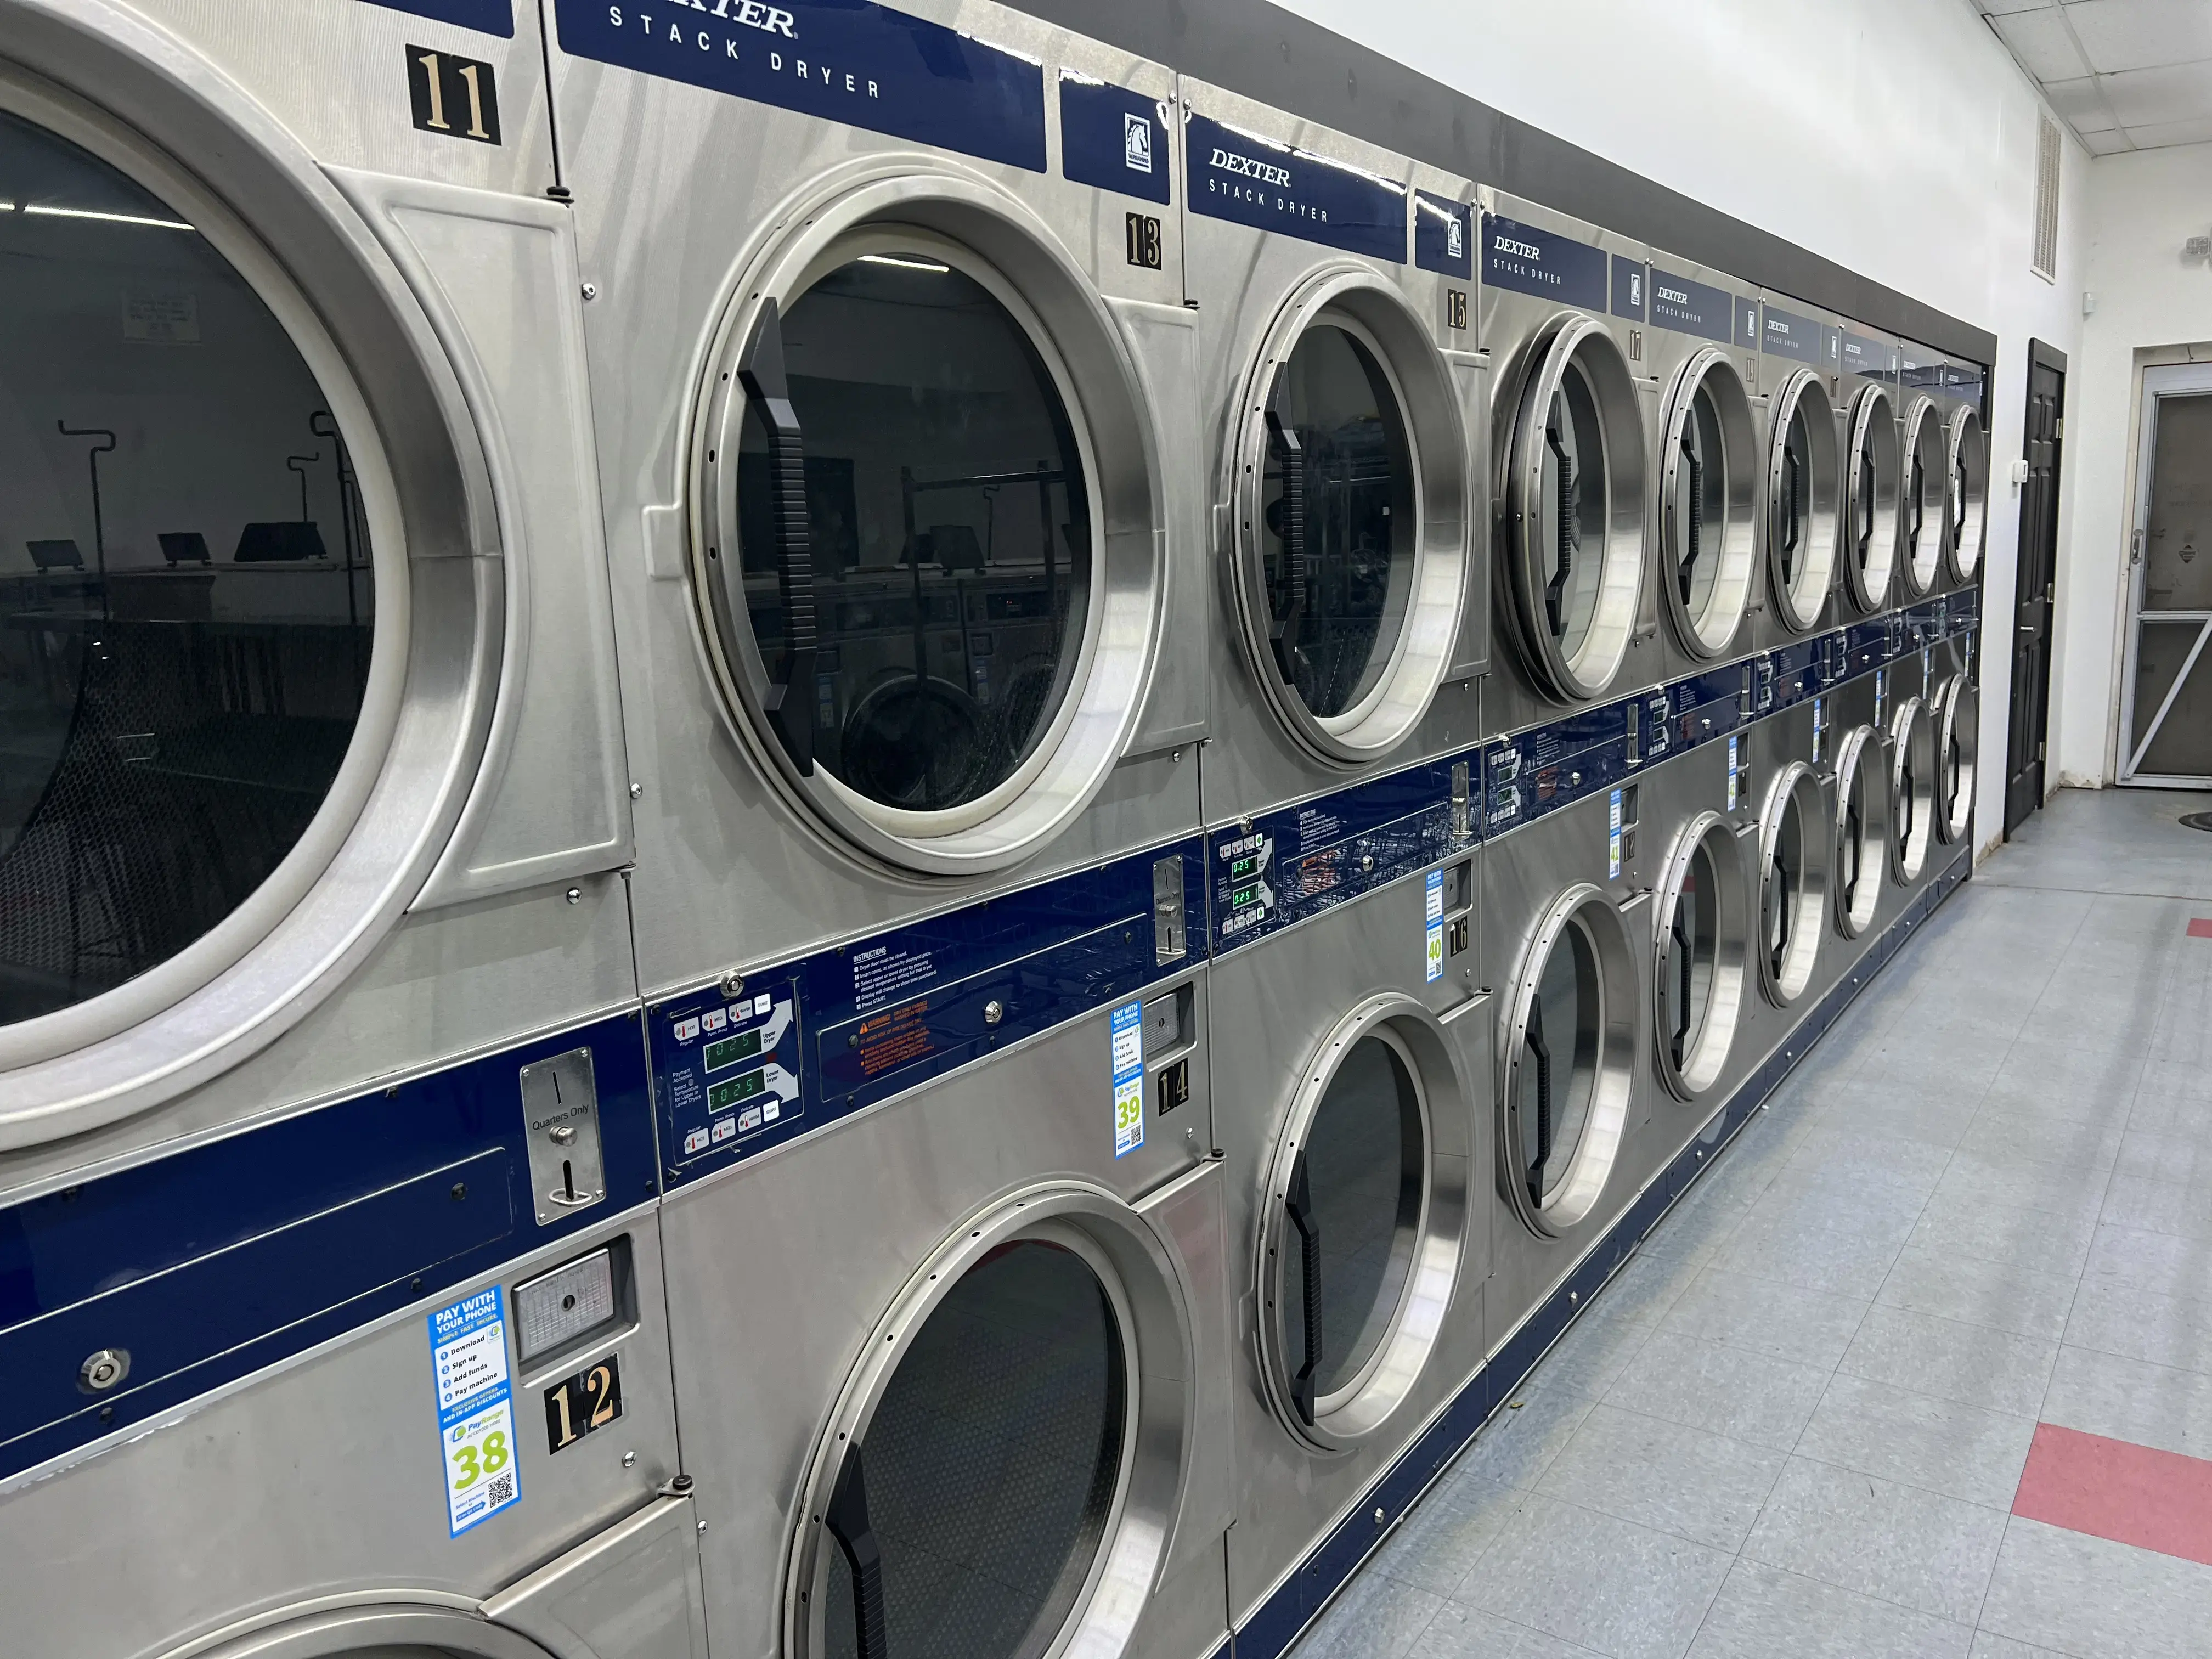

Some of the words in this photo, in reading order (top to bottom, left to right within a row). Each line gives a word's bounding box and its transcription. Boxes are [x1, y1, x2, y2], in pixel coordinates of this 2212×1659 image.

[610, 6, 739, 59] STACK
[771, 52, 878, 98] DRYER
[419, 54, 489, 139] 11
[1209, 148, 1290, 187] DEXTER
[1209, 179, 1264, 205] STACK
[1278, 198, 1327, 222] DRYER
[1128, 217, 1159, 266] 13
[1494, 236, 1539, 261] DEXTER
[1494, 258, 1525, 275] STACK
[1532, 269, 1560, 285] DRYER
[1657, 286, 1687, 304] DEXTER
[1450, 292, 1466, 328] 15
[1657, 304, 1677, 317] STACK
[1768, 320, 1789, 334] DEXTER
[1631, 332, 1640, 360] 17
[1625, 833, 1634, 861] 18
[1233, 860, 1249, 873] 0.25
[1234, 890, 1250, 905] 0.25
[1451, 919, 1466, 955] 16
[853, 946, 887, 963] INSTRUCTIONS
[1429, 939, 1441, 961] 40
[861, 992, 875, 1000] Display
[1113, 1010, 1124, 1019] PAY
[1124, 1003, 1138, 1014] WITH
[1114, 1016, 1125, 1025] YOUR
[1125, 1011, 1138, 1021] PHONE
[763, 1030, 776, 1039] Upper
[673, 1068, 691, 1078] Payment
[673, 1073, 692, 1084] Accepted
[766, 1069, 779, 1077] Lower
[674, 1085, 699, 1097] Temperature
[681, 1092, 694, 1101] Upper
[1160, 1062, 1187, 1113] 14
[689, 1094, 701, 1103] Dryers
[741, 1104, 754, 1113] Delicate
[533, 1110, 568, 1130] Quarters
[570, 1104, 589, 1118] Only
[1118, 1096, 1140, 1129] 39
[687, 1126, 701, 1134] Regular
[436, 1305, 460, 1325] PAY
[461, 1290, 495, 1313] WITH
[437, 1317, 464, 1334] YOUR
[465, 1301, 496, 1322] PHONE
[451, 1335, 485, 1355] Download
[452, 1358, 467, 1369] Sign
[454, 1372, 467, 1383] Add
[469, 1363, 488, 1376] funds
[455, 1386, 467, 1396] Pay
[469, 1372, 498, 1390] machine
[443, 1413, 455, 1424] AND
[456, 1403, 476, 1417] IN-APP
[476, 1387, 507, 1407] DISCOUNTS
[552, 1366, 613, 1447] 12
[467, 1425, 489, 1439] ACCEPTED
[489, 1419, 500, 1427] HERE
[468, 1409, 504, 1431] PayRange
[453, 1431, 509, 1489] 38
